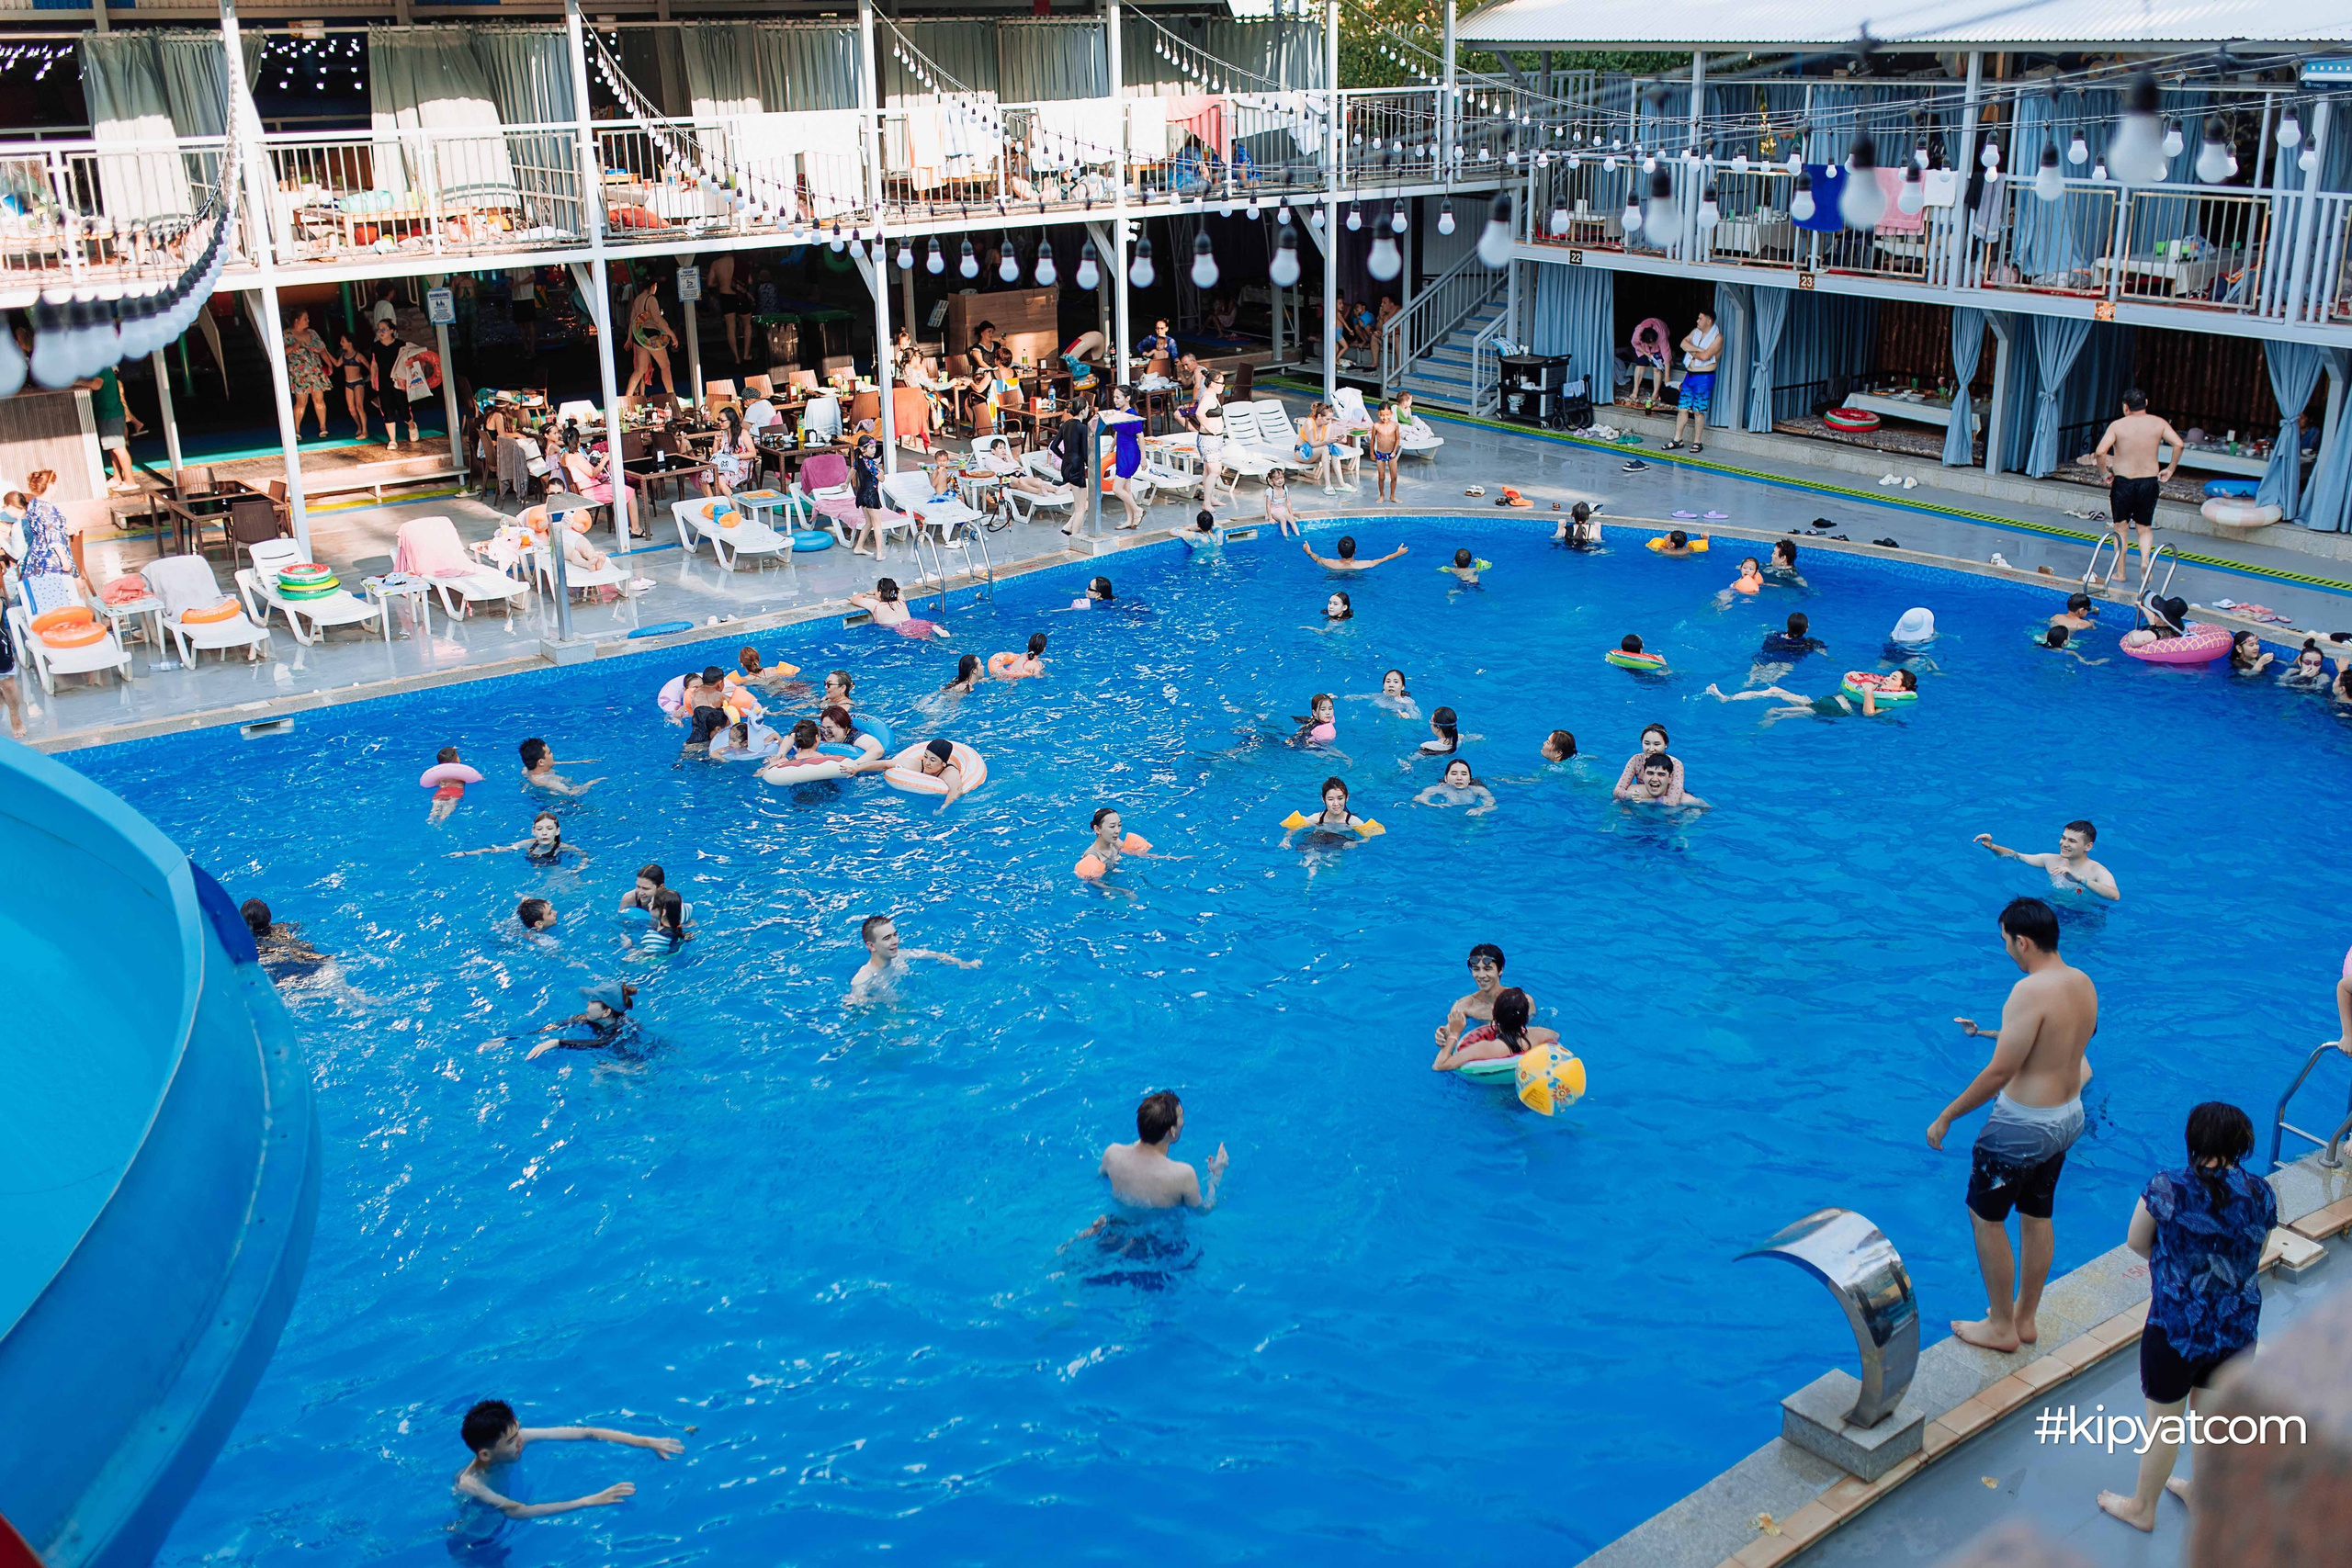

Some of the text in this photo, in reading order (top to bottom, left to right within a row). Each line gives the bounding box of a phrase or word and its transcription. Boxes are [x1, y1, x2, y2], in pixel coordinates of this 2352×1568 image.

[1570, 253, 1581, 263] 22
[1801, 276, 1813, 288] 23
[2121, 1264, 2150, 1280] 150
